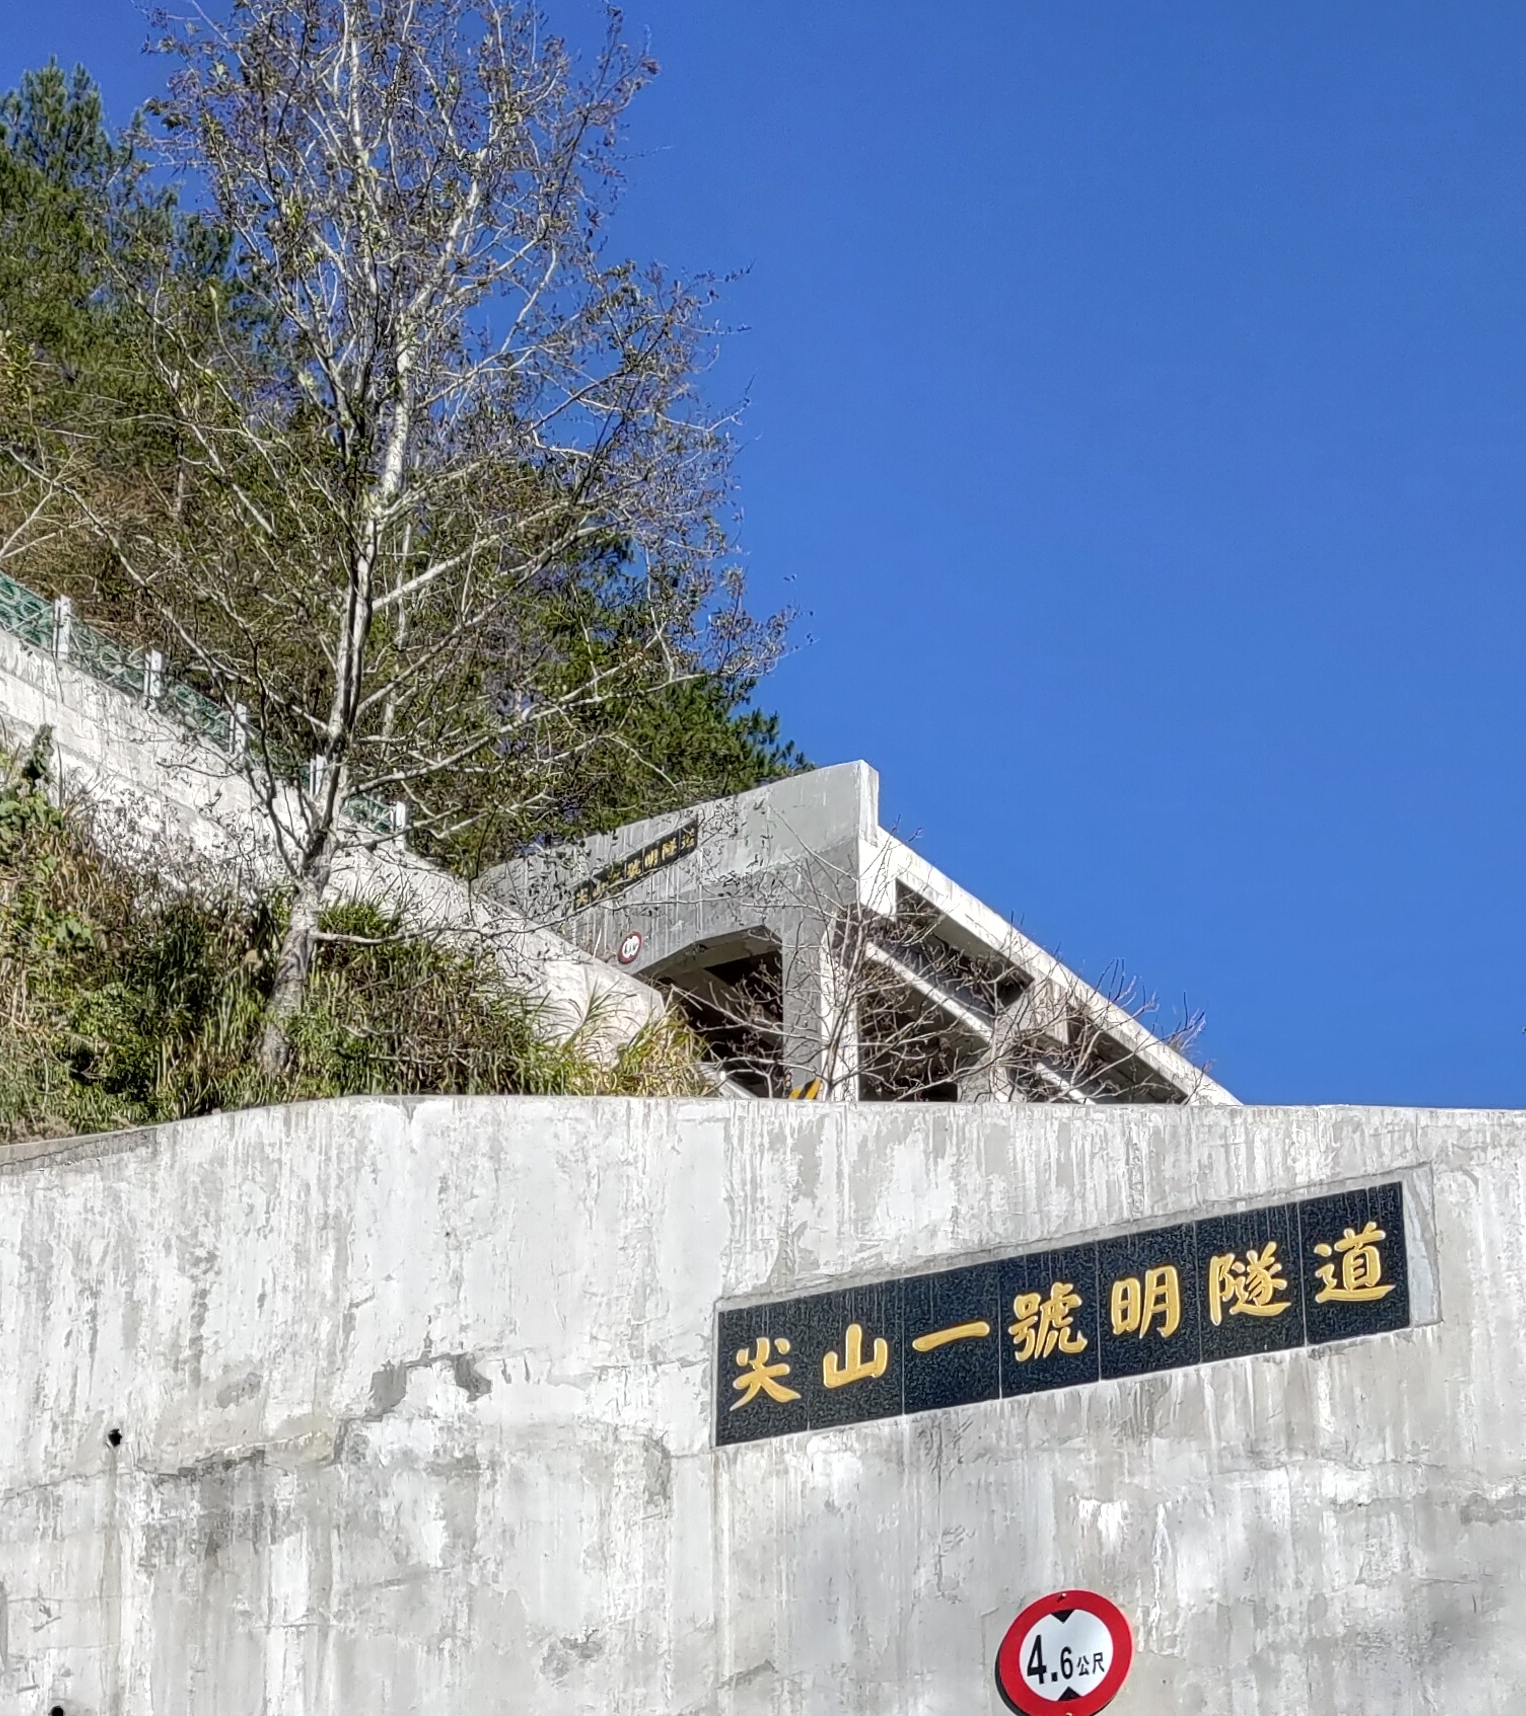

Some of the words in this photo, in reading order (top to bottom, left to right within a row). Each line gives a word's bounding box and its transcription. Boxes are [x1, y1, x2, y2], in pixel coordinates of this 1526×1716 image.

[731, 1221, 1395, 1411] 尖山一號明隧道
